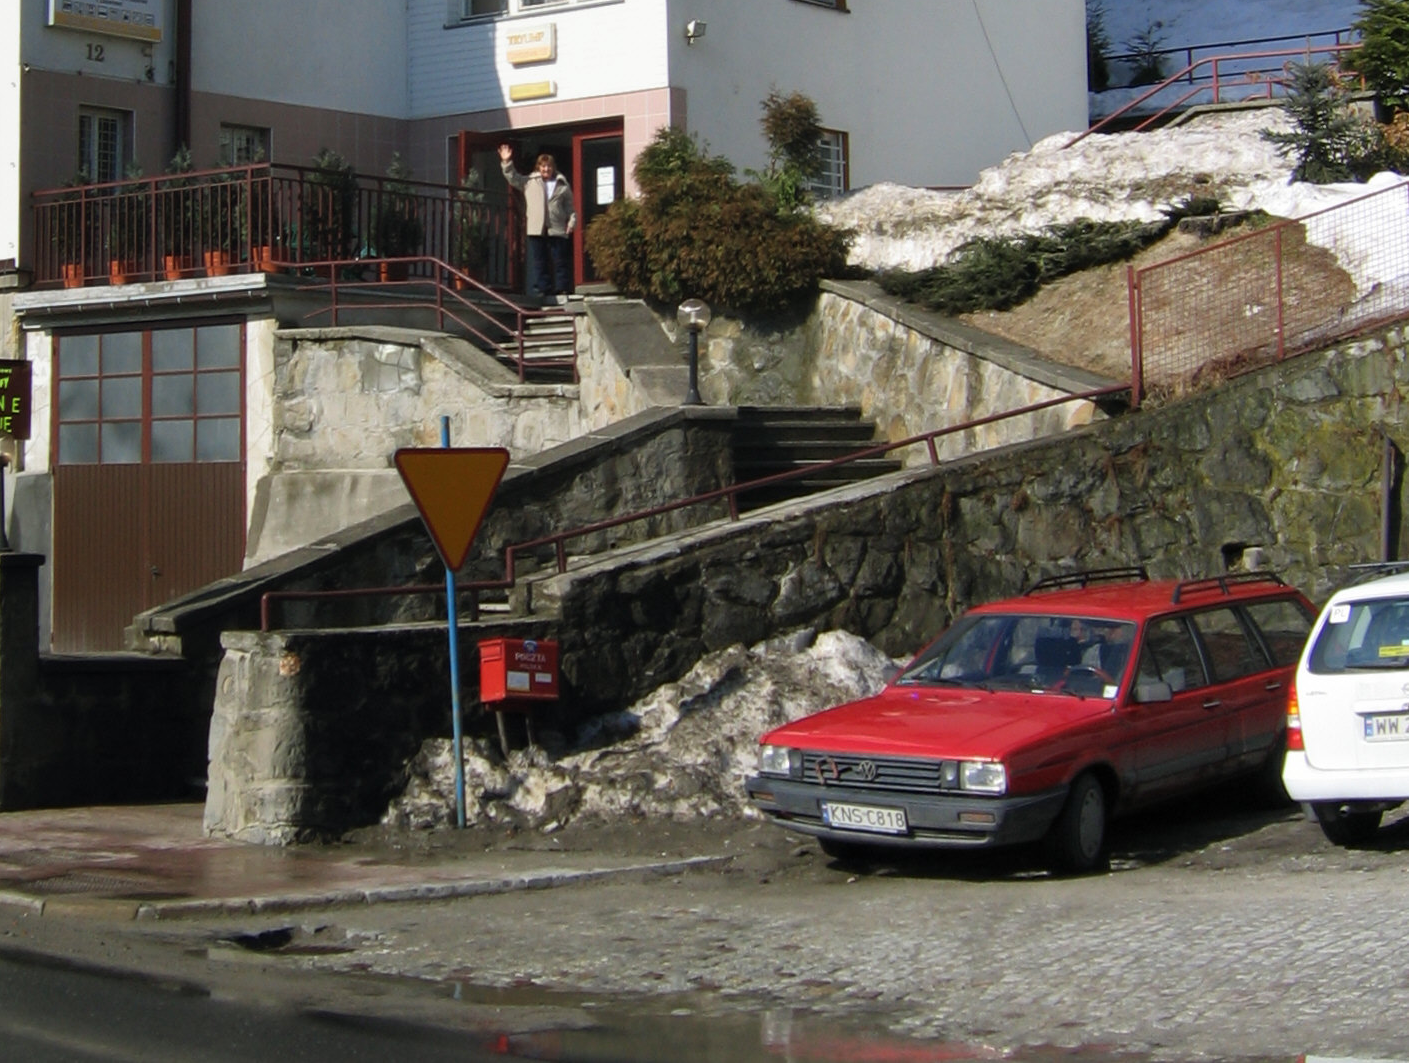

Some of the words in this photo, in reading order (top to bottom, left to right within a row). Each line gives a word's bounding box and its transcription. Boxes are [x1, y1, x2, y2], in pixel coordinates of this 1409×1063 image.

[86, 42, 105, 62] 12
[1375, 717, 1399, 735] WW
[830, 805, 863, 824] KNS
[866, 809, 905, 828] C818
